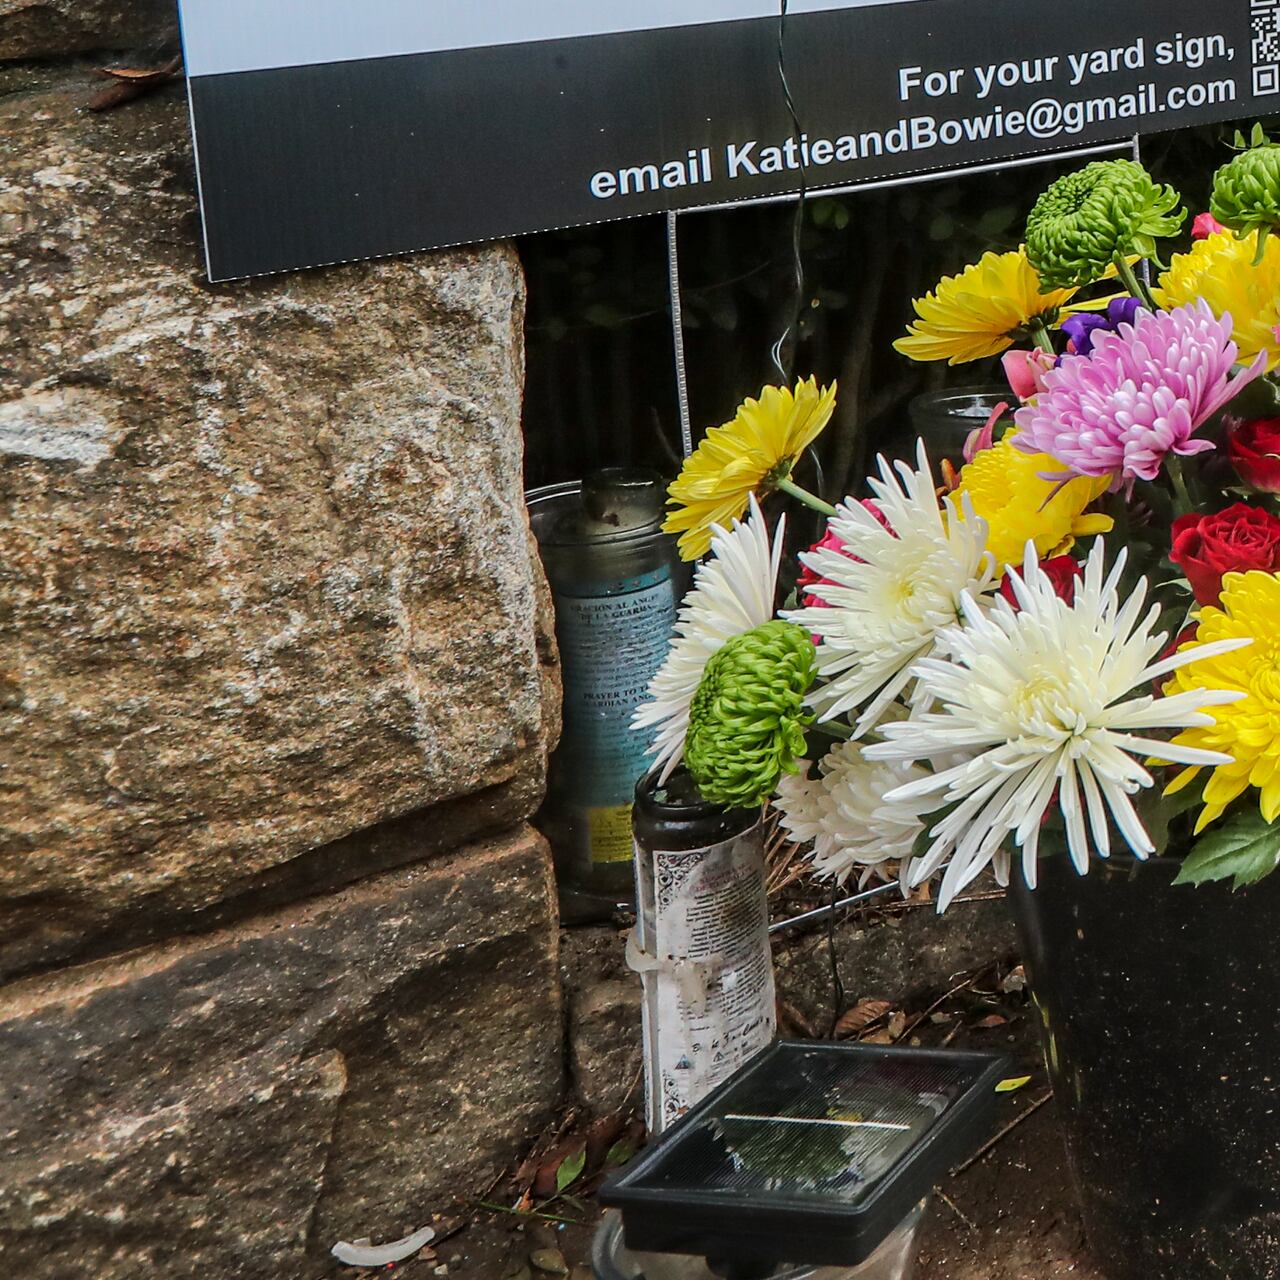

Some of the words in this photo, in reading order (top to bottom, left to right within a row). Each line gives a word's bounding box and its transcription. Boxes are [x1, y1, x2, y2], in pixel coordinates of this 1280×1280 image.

[899, 66, 964, 102] For
[975, 55, 1058, 100] your
[1069, 39, 1146, 86] yard
[1155, 30, 1236, 70] sign,
[590, 148, 711, 199] email
[727, 75, 1237, 176] KatieandBowie@gmail.com
